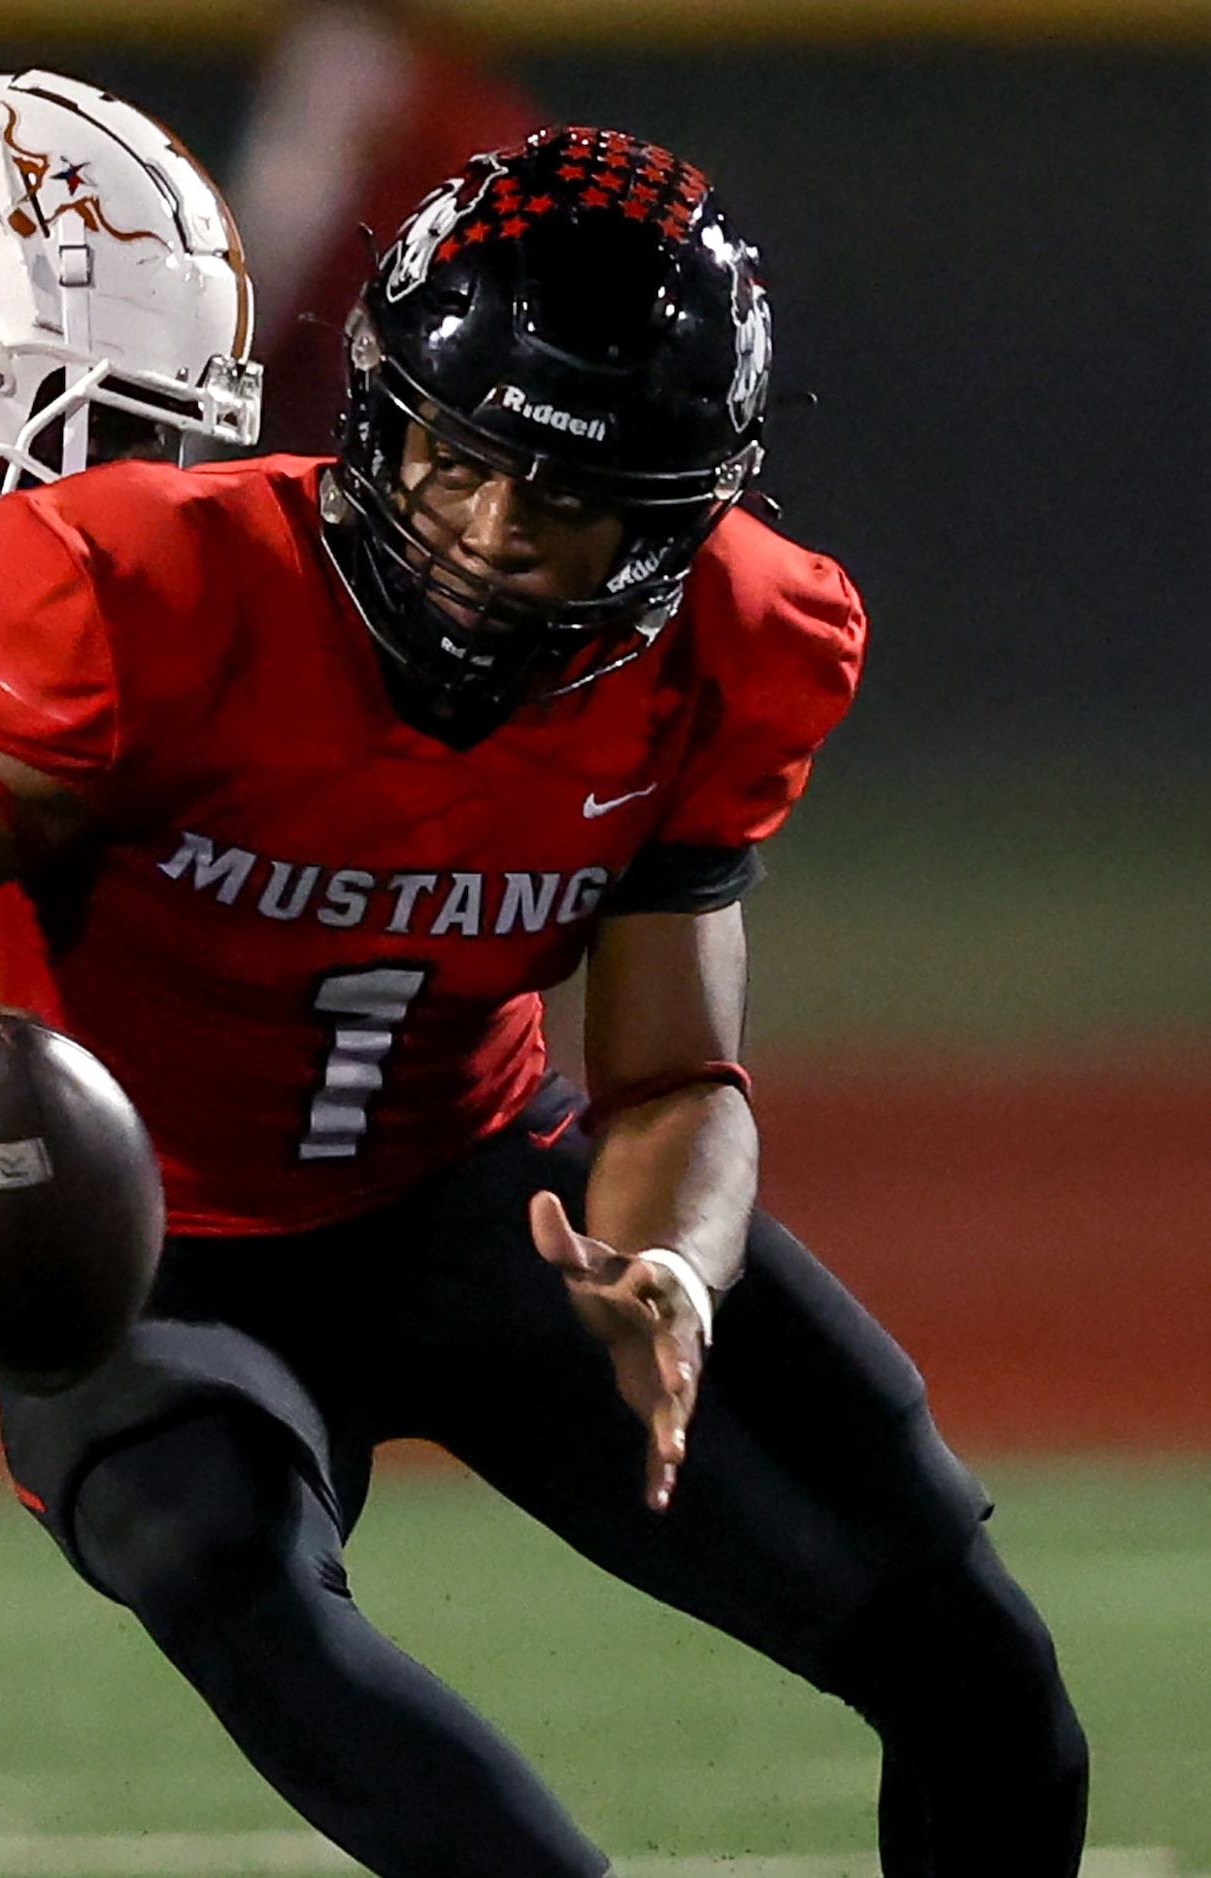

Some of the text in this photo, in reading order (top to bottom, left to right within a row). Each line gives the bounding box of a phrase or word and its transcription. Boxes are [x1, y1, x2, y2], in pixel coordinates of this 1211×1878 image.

[502, 385, 606, 441] Riddell
[157, 831, 628, 935] MUSTANG
[299, 968, 426, 1159] 1
